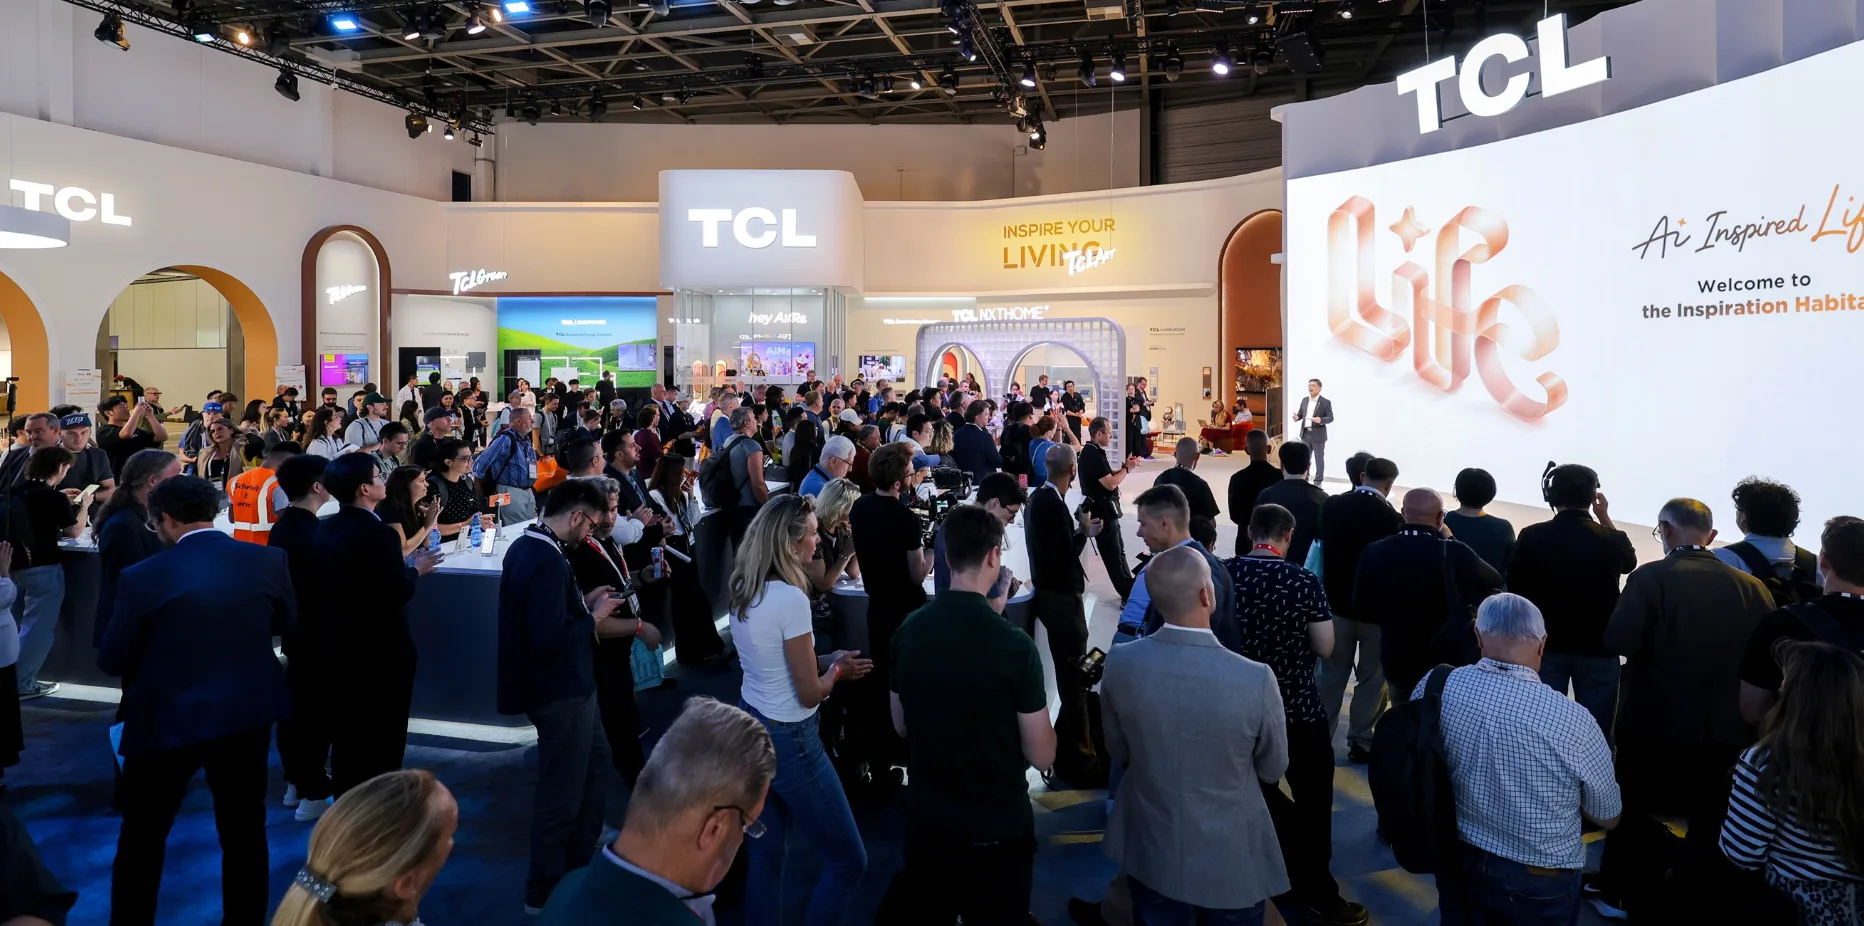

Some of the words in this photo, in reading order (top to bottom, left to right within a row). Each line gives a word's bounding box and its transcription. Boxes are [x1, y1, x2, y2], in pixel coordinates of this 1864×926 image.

[1396, 13, 1612, 134] TCL
[9, 179, 132, 226] TCL
[688, 207, 816, 249] TCL
[1004, 222, 1063, 238] INSPIRE
[1067, 218, 1115, 233] YOUR
[1632, 215, 1691, 259] Ai
[1695, 204, 1808, 252] Inspired
[1698, 277, 1785, 293] Welcome
[1792, 273, 1811, 287] to
[748, 312, 773, 325] hey
[952, 309, 979, 323] TCL
[1642, 305, 1671, 318] the
[1677, 298, 1788, 319] Inspiration
